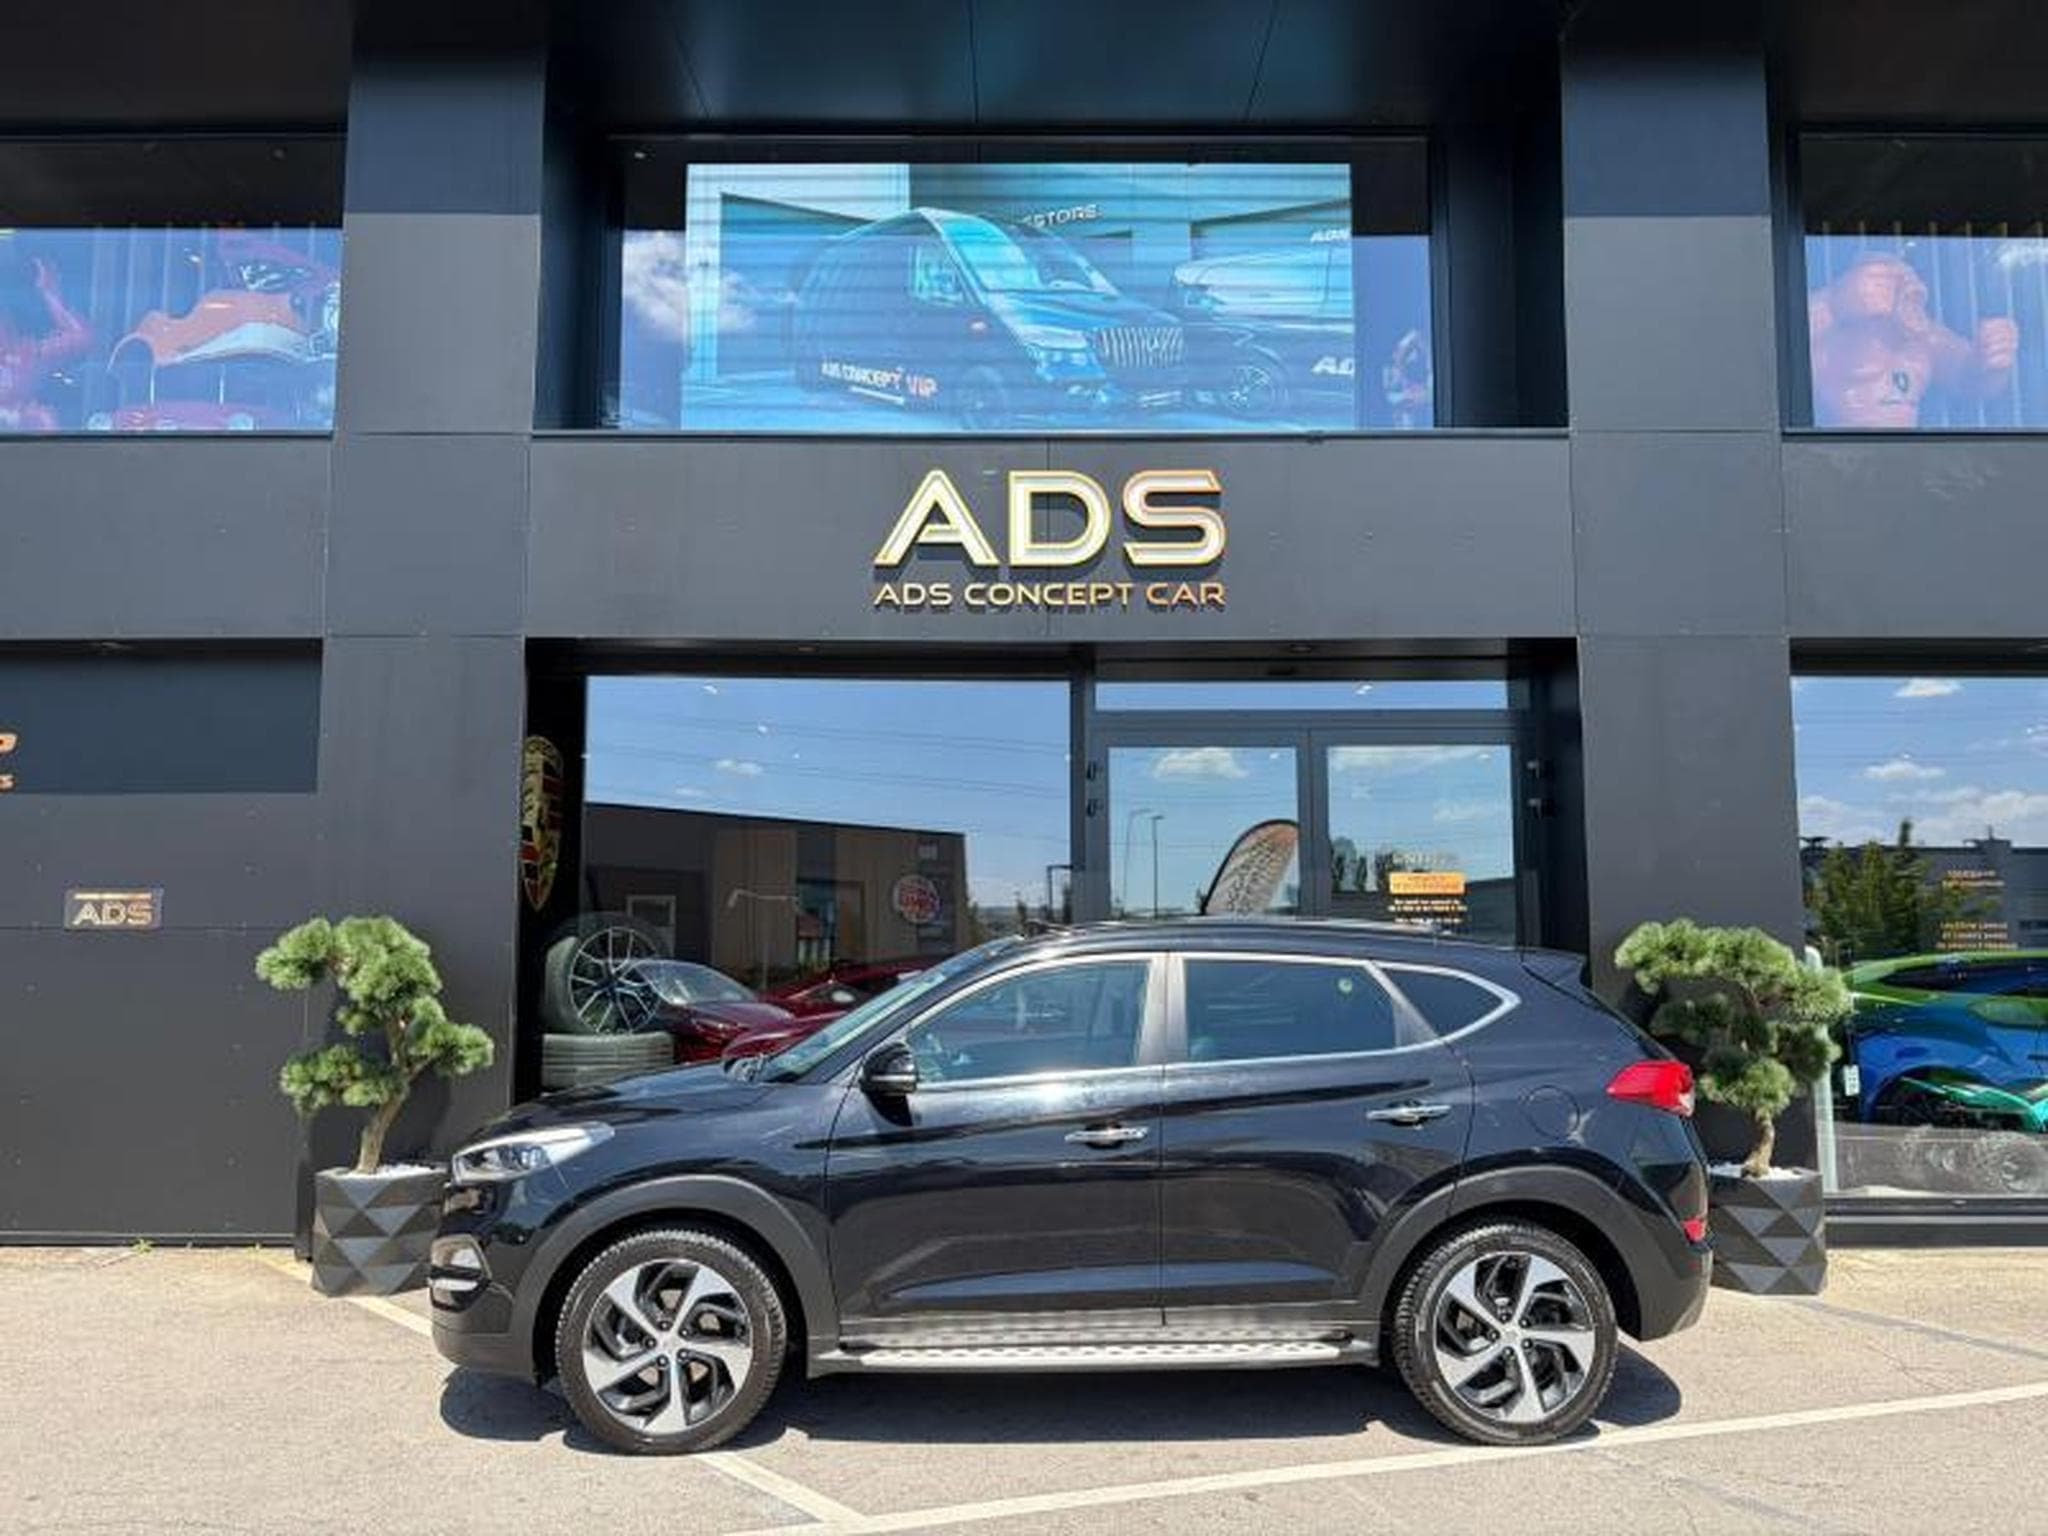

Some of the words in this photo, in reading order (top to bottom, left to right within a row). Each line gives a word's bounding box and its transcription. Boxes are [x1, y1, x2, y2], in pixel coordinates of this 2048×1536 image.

[873, 469, 1226, 566] ADS
[873, 582, 953, 606] ADS
[964, 582, 1135, 606] CONCEPT
[1146, 582, 1226, 606] CAR
[72, 901, 152, 925] ADS
